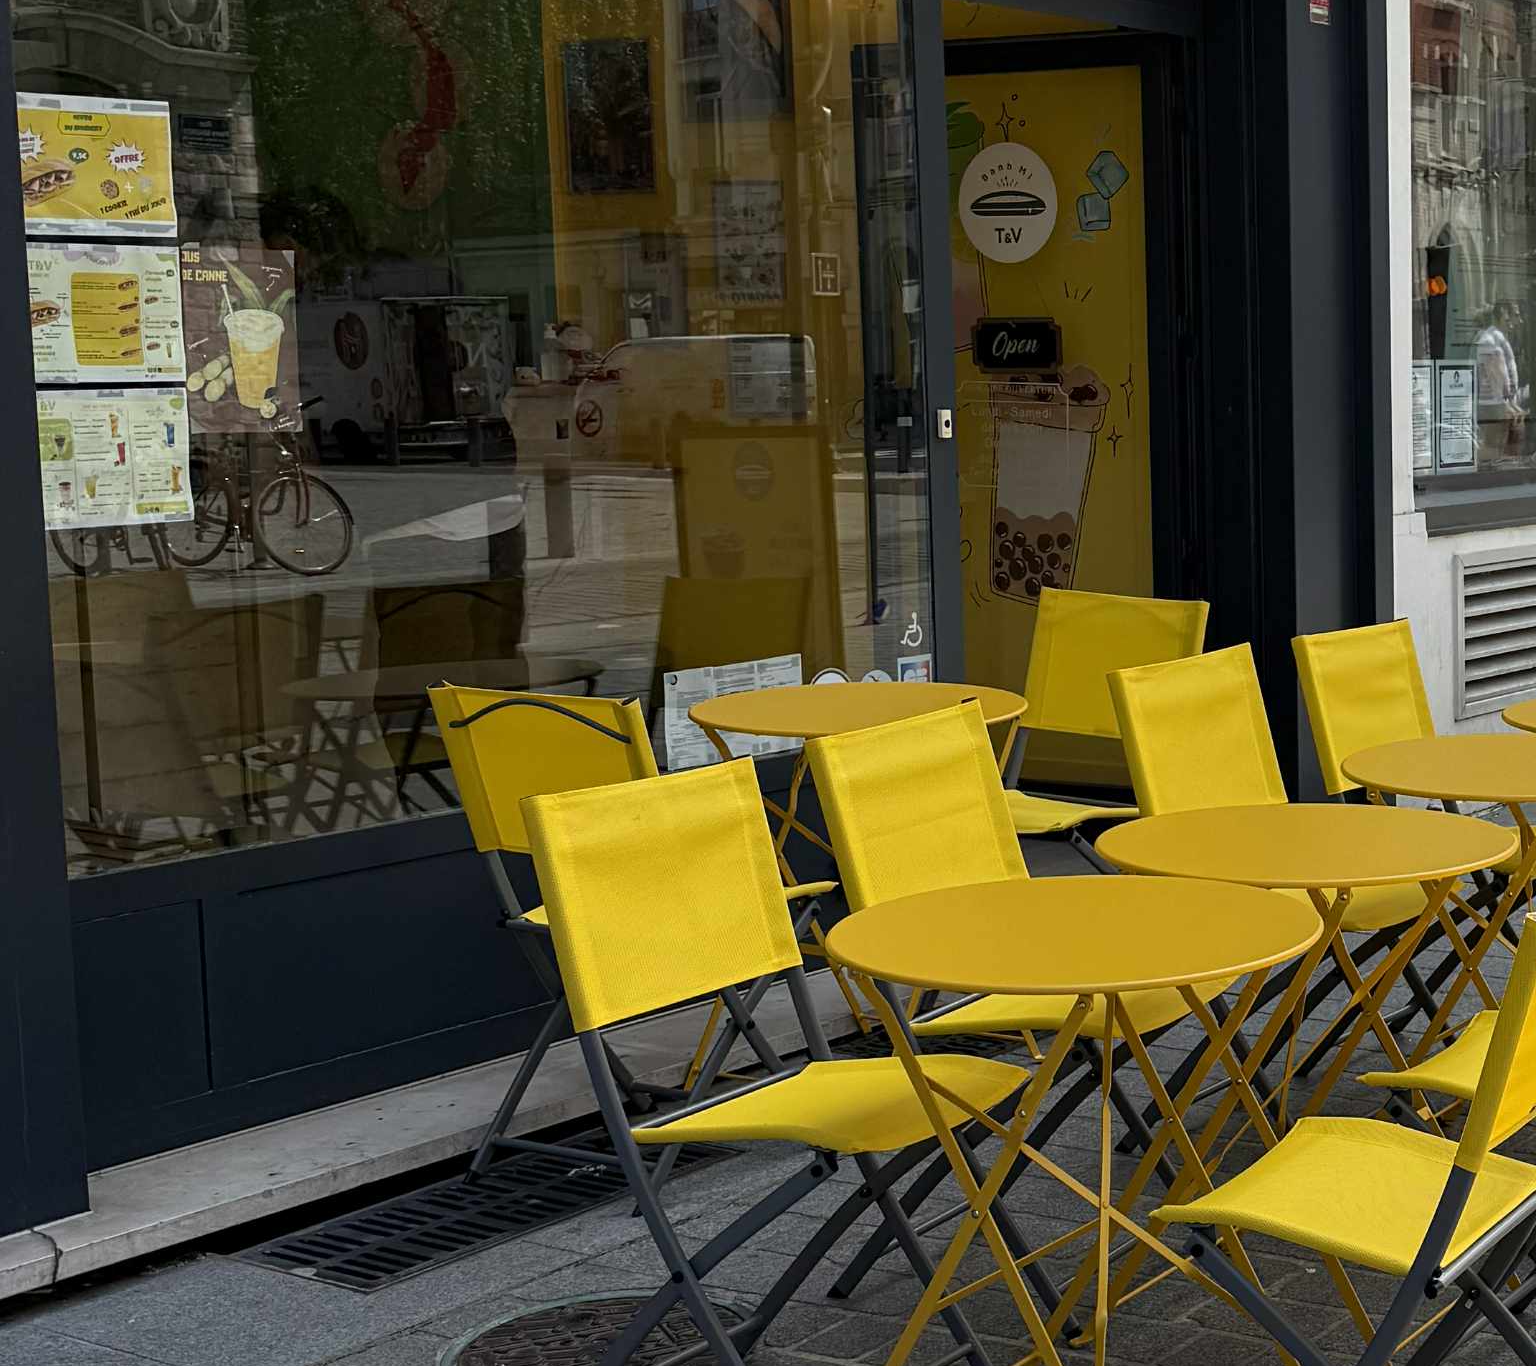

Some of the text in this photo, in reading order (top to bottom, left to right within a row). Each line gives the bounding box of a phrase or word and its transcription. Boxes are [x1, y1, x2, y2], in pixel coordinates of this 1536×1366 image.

[114, 153, 139, 164] OFFRE
[995, 227, 1022, 243] T&V
[181, 251, 199, 263] JUS
[182, 269, 228, 282] DE CANNE
[992, 331, 1037, 360] Open
